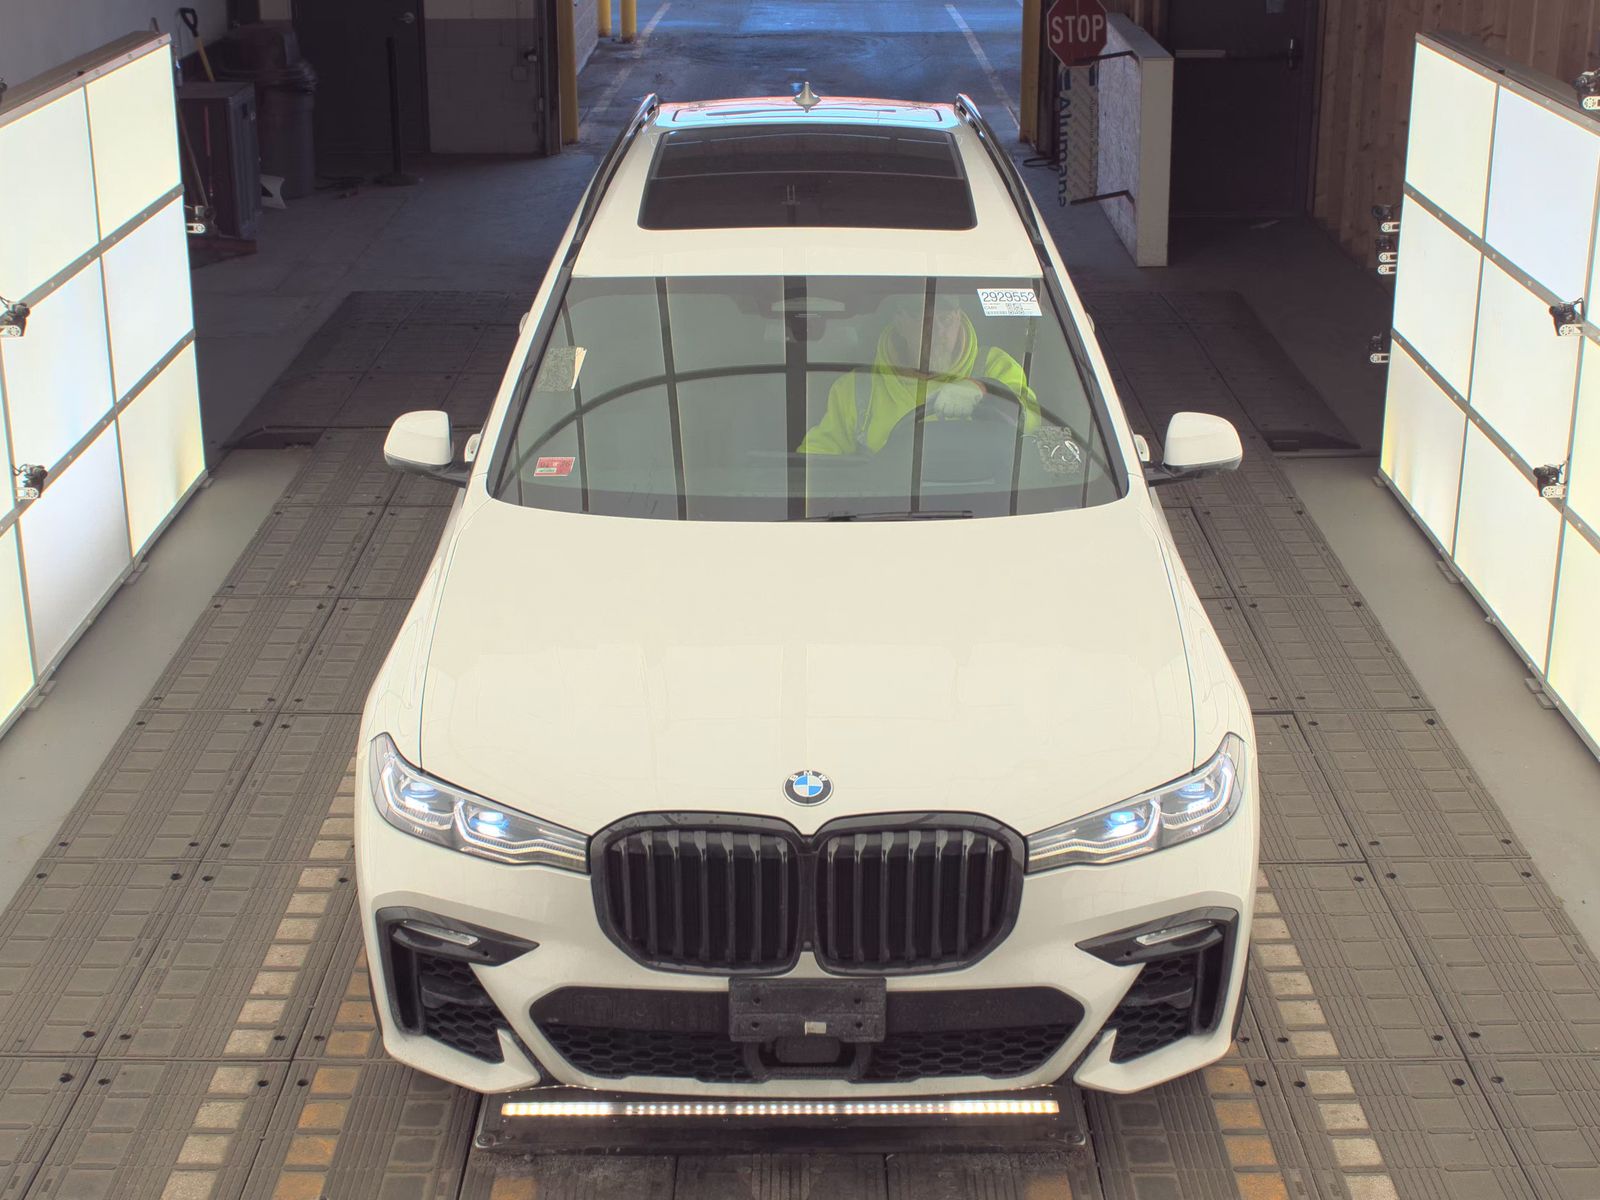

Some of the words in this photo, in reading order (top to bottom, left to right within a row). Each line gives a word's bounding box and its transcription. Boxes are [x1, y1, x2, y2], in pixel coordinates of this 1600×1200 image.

[1051, 14, 1104, 44] STOP
[981, 291, 1037, 303] 2929552
[789, 769, 828, 781] BMW
